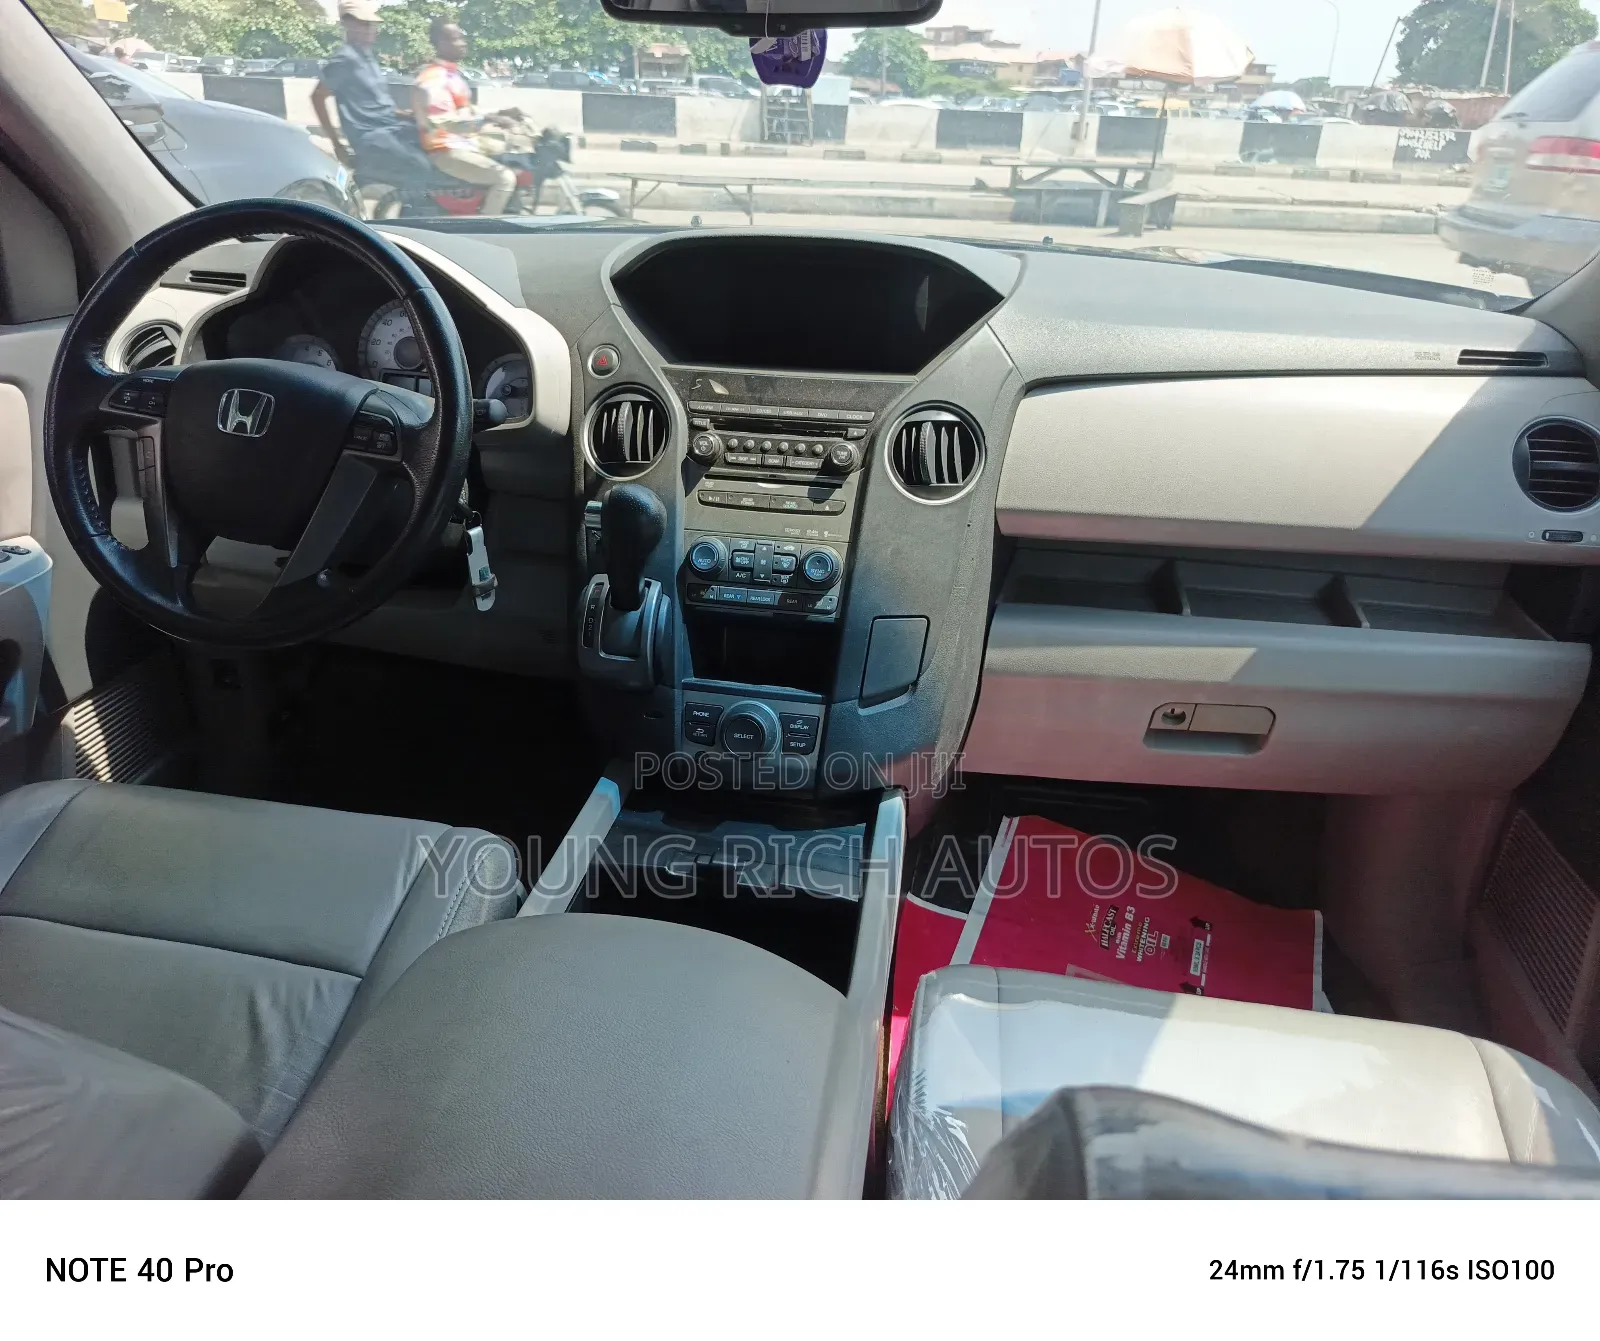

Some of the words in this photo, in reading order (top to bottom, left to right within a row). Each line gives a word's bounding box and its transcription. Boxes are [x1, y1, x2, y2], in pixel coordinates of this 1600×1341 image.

[733, 732, 754, 740] SELECT
[1101, 908, 1117, 948] HALFCAST
[1115, 922, 1132, 959] Vitamin
[1124, 905, 1136, 922] B3
[1136, 916, 1150, 962] WHITENING
[1144, 930, 1159, 956] OIL
